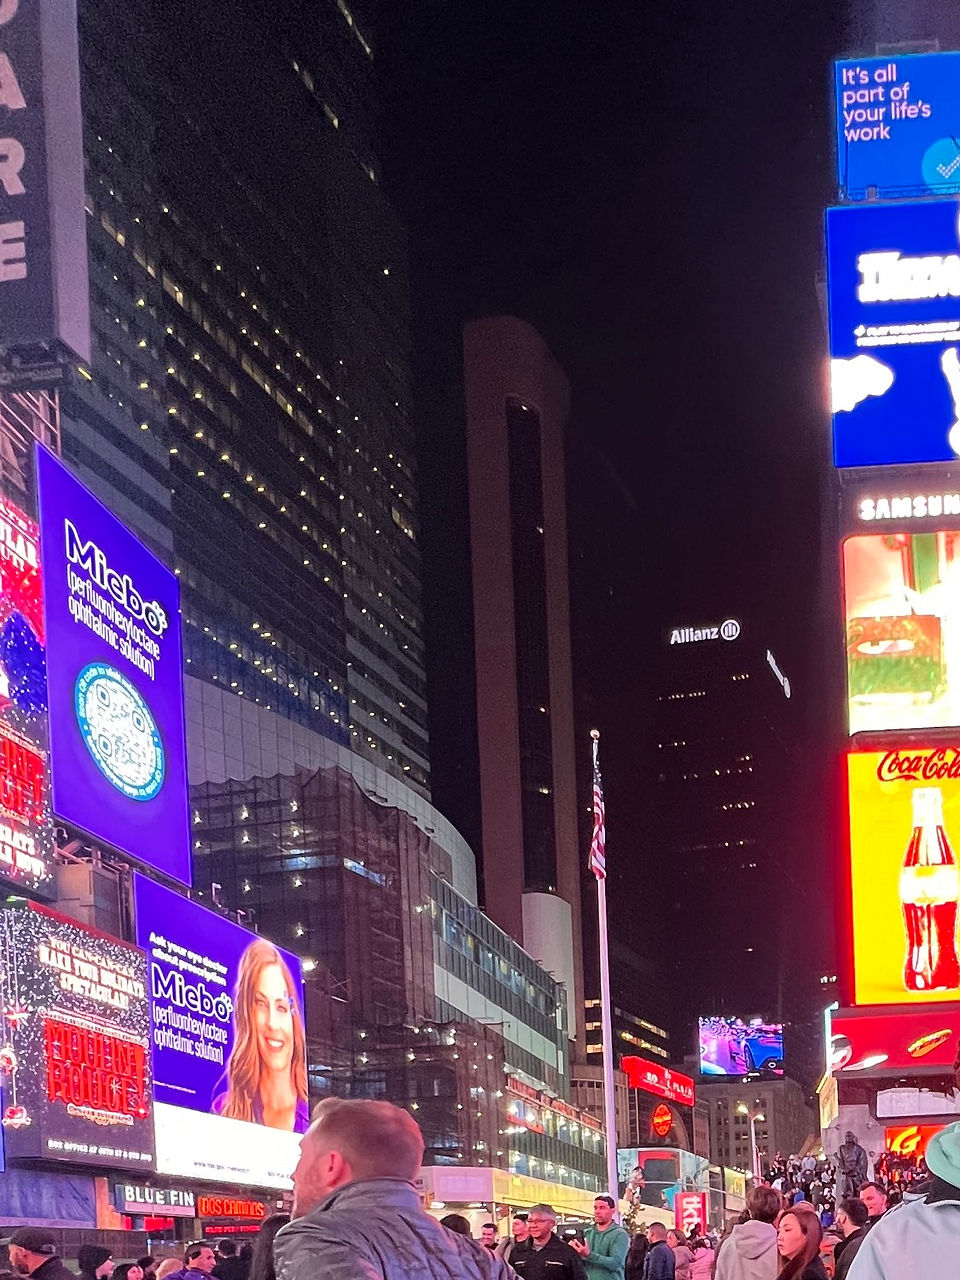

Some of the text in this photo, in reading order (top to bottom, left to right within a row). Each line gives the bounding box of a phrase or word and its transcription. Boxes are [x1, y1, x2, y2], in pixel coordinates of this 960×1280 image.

[842, 63, 897, 85] It's all
[843, 81, 910, 108] part of
[843, 99, 931, 127] your life's
[844, 122, 890, 142] work
[65, 518, 166, 636] Miebo
[670, 627, 719, 645] Allianz
[152, 962, 232, 1023] Miebo
[125, 1185, 195, 1207] BLUE FIN
[202, 1197, 222, 1216] DOS
